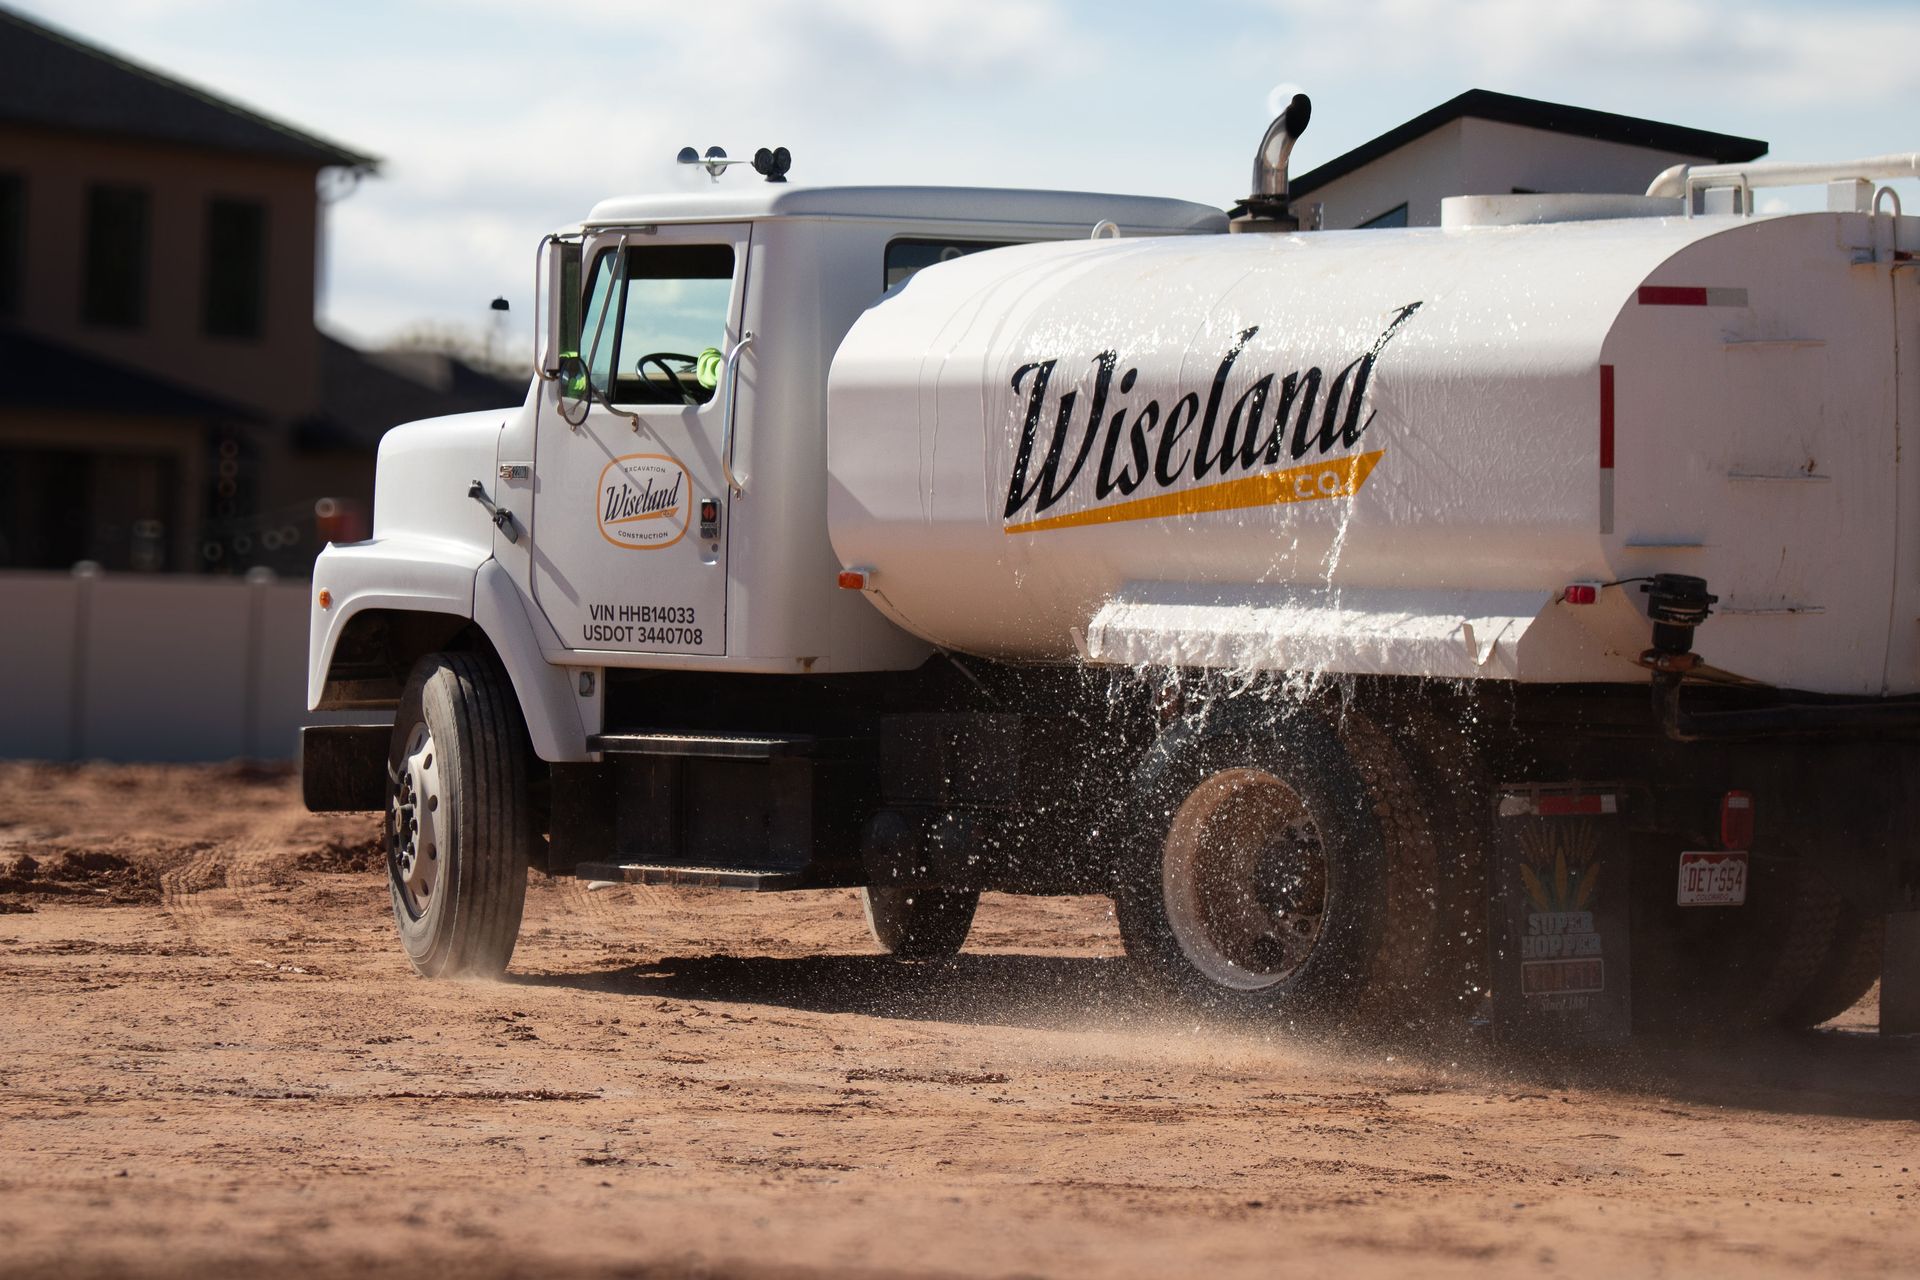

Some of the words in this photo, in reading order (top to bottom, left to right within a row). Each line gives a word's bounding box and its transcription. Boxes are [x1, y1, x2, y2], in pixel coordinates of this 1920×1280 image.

[1003, 301, 1423, 519] Wiseland
[604, 471, 682, 522] Wiseland
[618, 530, 668, 540] CONSTRUCTION
[589, 604, 615, 621] VIN
[619, 605, 695, 624] HHB14033
[583, 624, 634, 642] USDOT
[638, 626, 703, 645] 3440708
[1528, 912, 1594, 936] SUPER
